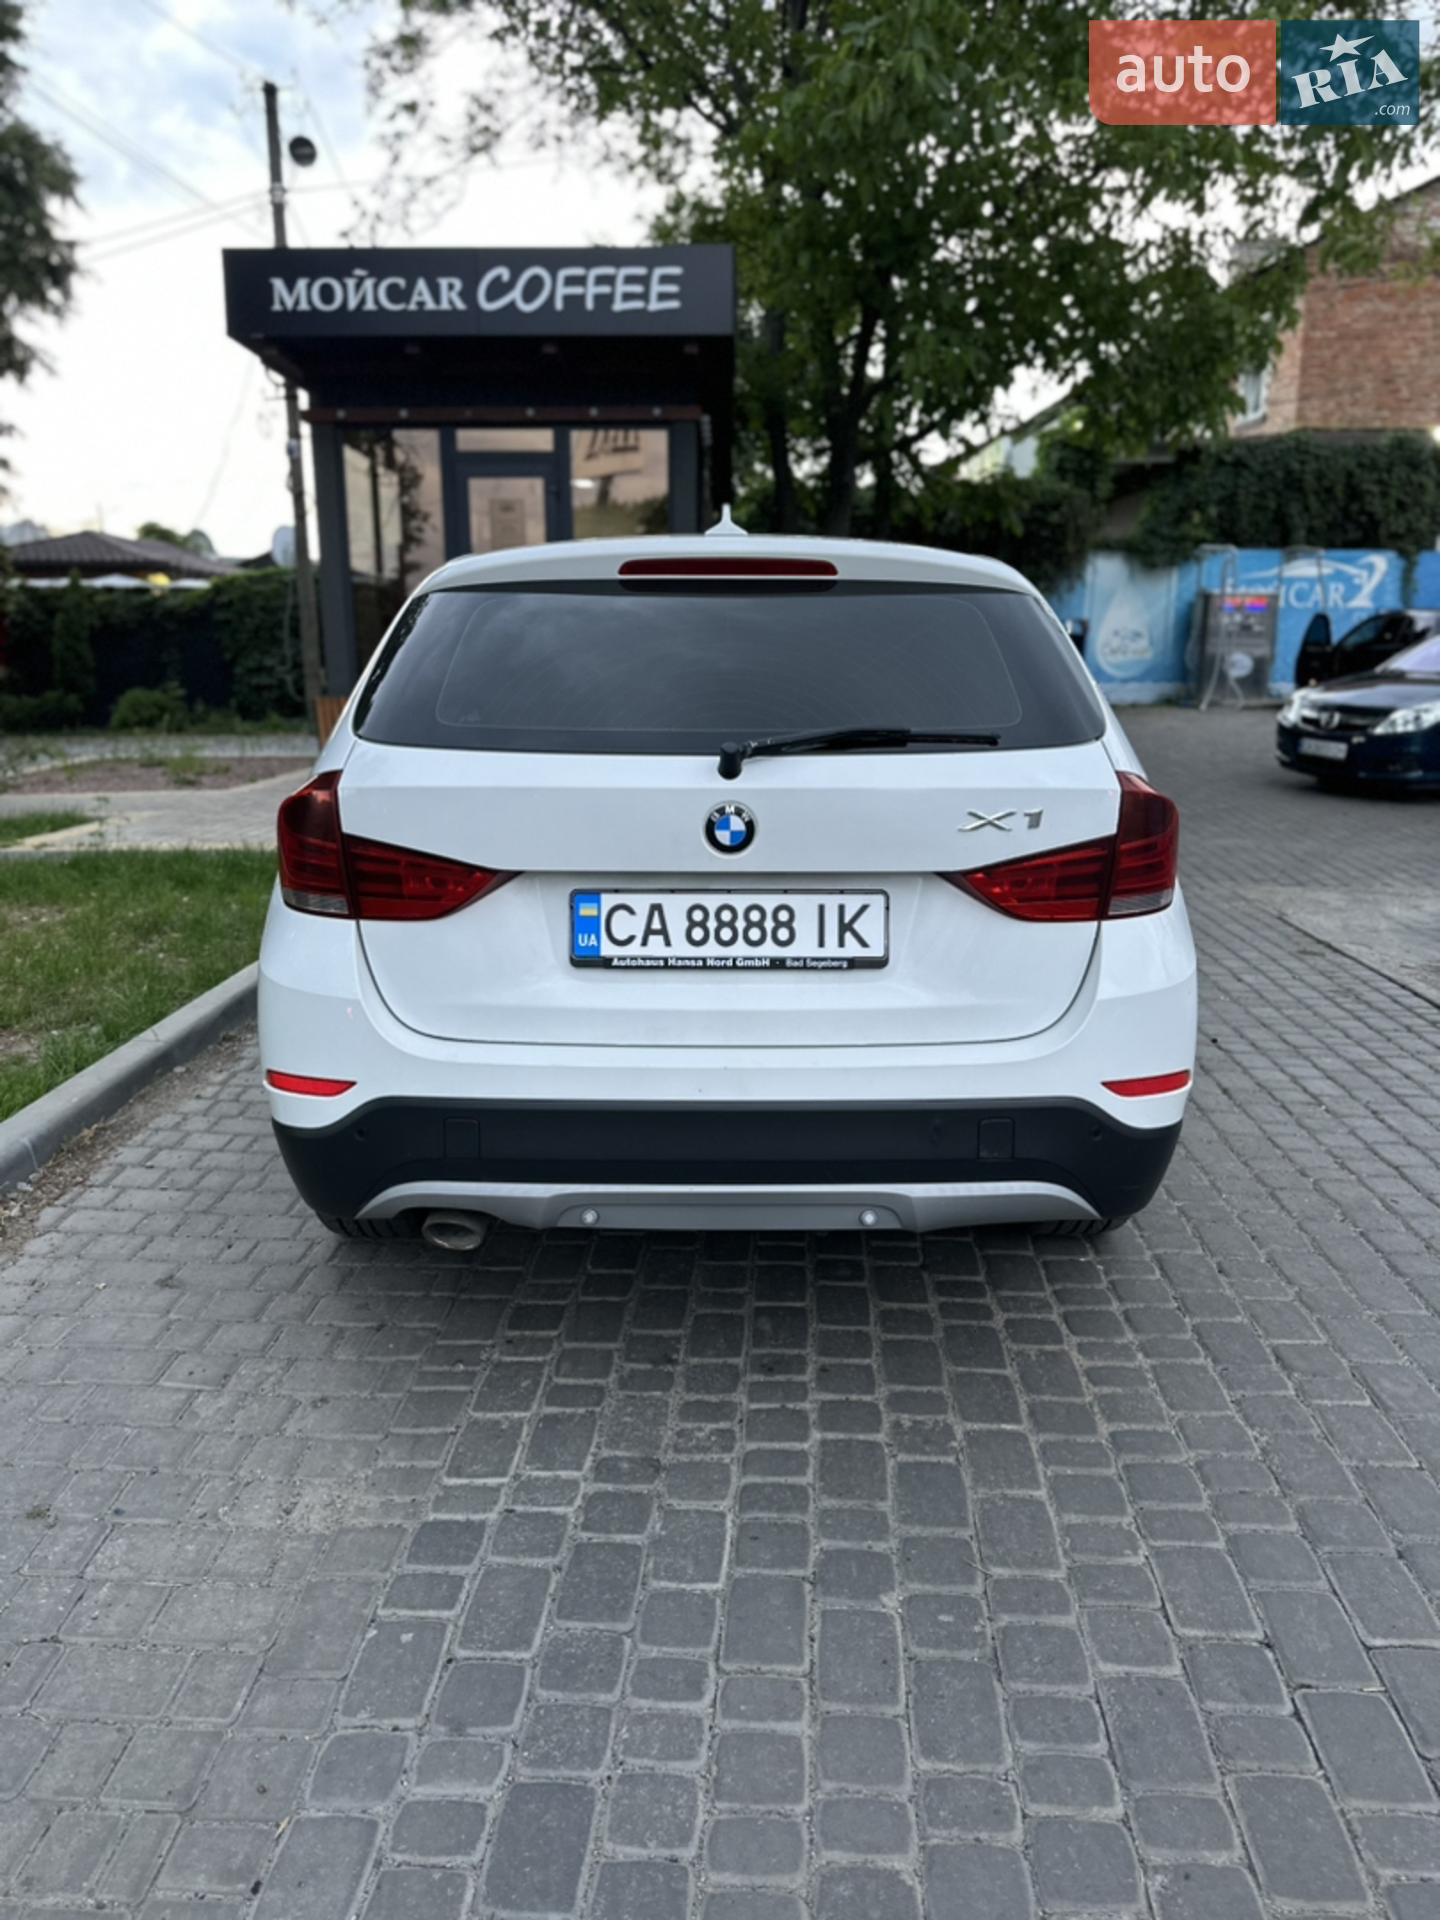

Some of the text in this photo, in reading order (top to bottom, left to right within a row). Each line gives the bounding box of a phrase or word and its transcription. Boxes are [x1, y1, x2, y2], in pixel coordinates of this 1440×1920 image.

[476, 265, 684, 313] COFFEE
[957, 808, 1043, 832] X1
[604, 903, 871, 948] CA 8888 IK
[578, 933, 598, 947] UA
[611, 957, 848, 969] Autohaus Hansa Nord GmbH Bad Segeberg
